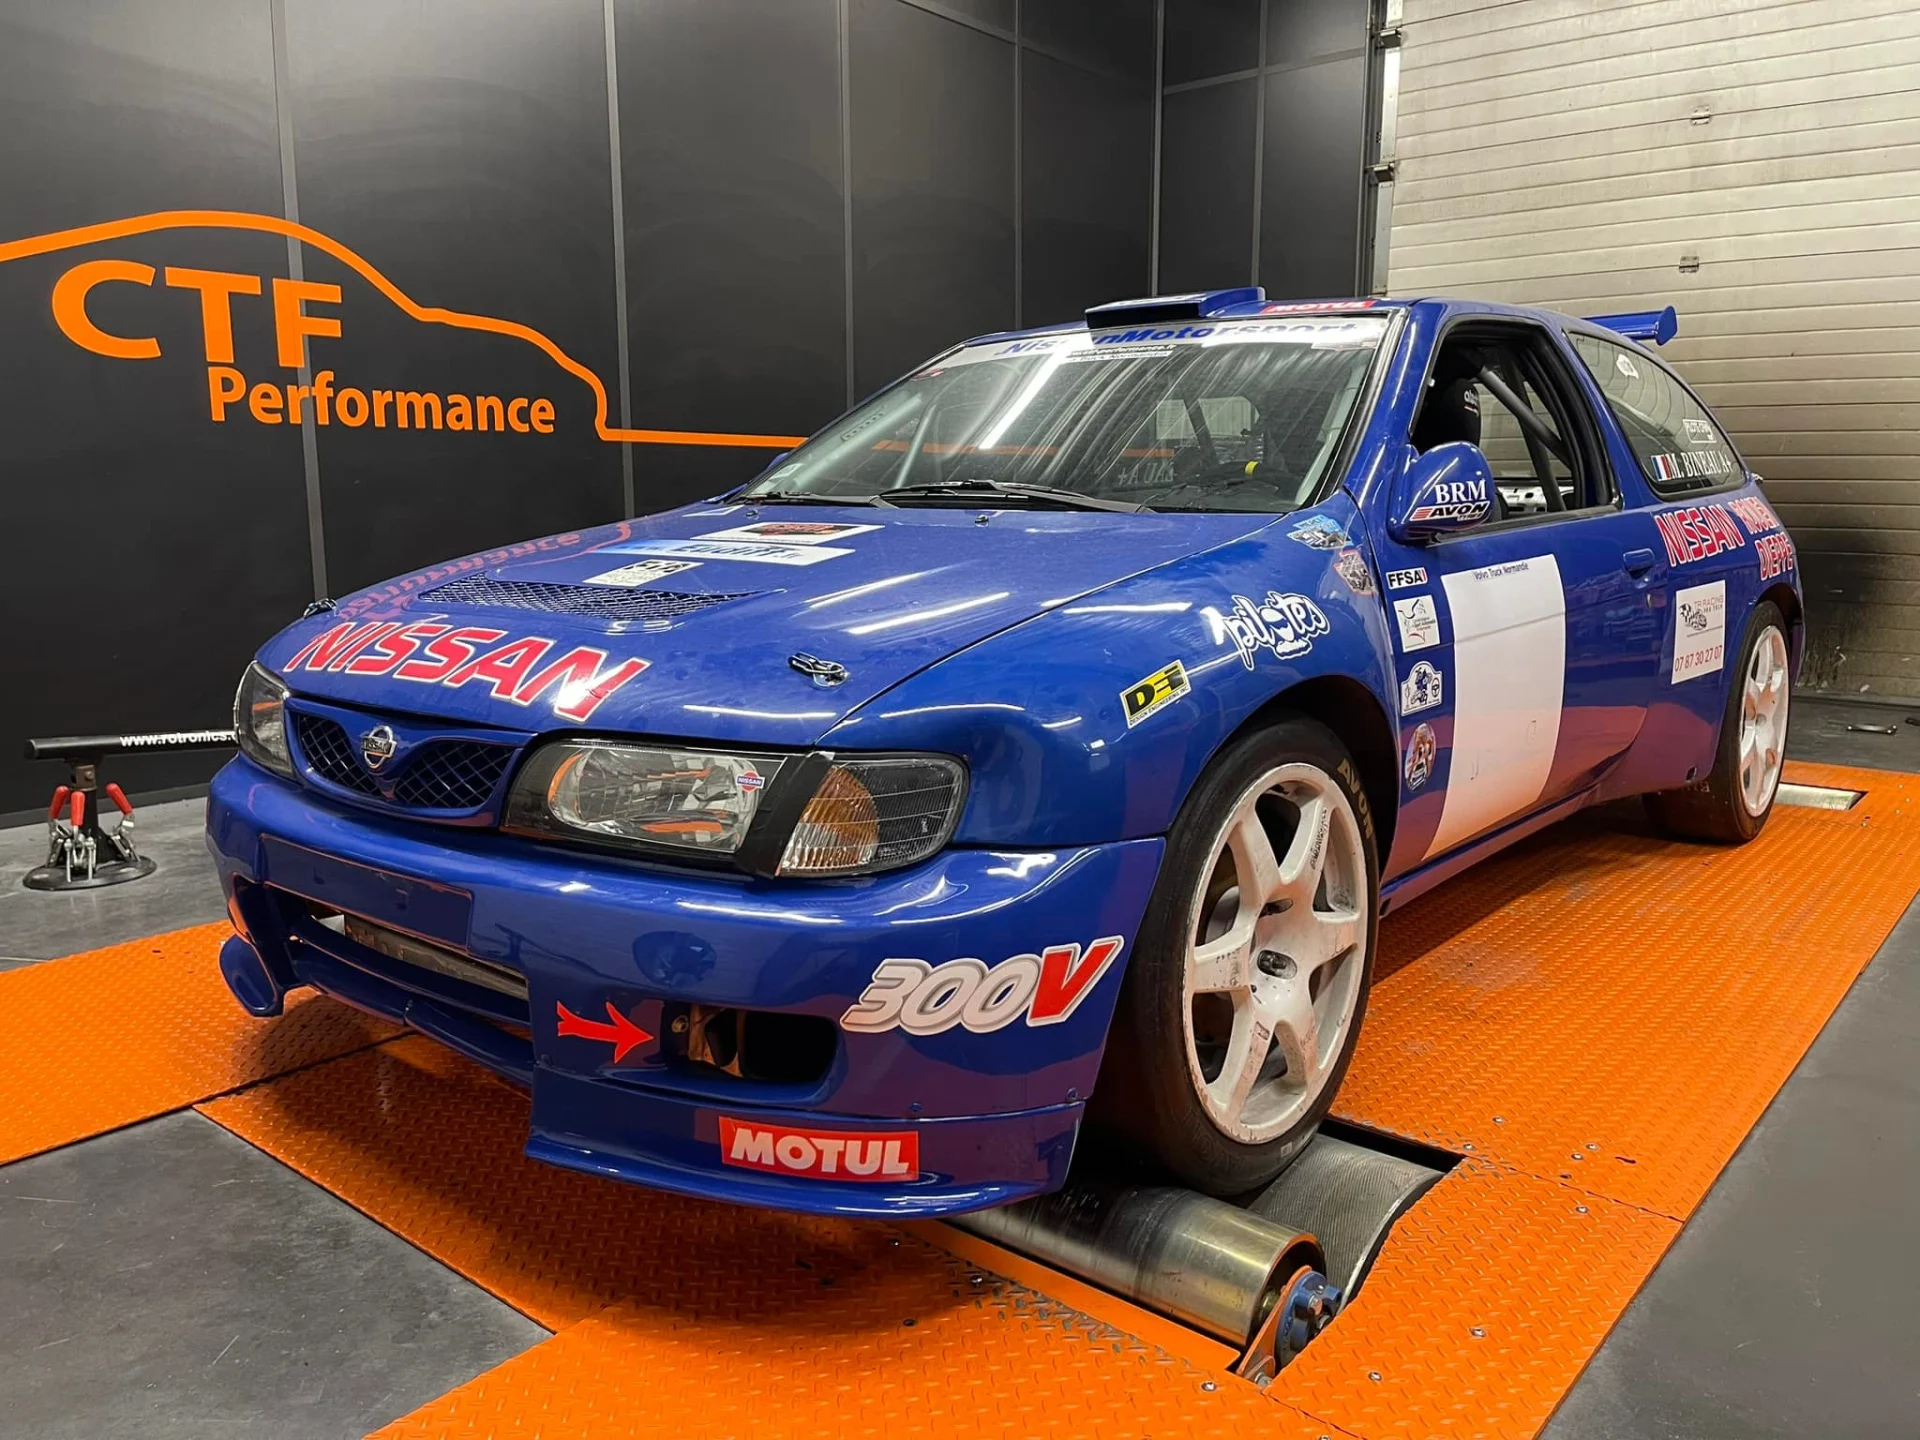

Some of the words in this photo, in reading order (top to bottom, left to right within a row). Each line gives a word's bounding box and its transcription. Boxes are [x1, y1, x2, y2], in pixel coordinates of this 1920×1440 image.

[52, 260, 342, 368] CTF
[1269, 301, 1366, 312] MOTUL
[208, 366, 556, 434] Performance
[1680, 450, 1722, 478] BINEAU
[1434, 478, 1487, 505] BRM
[1430, 502, 1489, 517] AVON
[1653, 503, 1746, 568] NISSAN
[1387, 568, 1424, 588] FFSA
[283, 621, 652, 724] NISSAN
[1674, 655, 1684, 673] 07
[1684, 652, 1694, 669] 87
[1694, 649, 1704, 666] 30
[1704, 647, 1714, 663] 27
[1714, 644, 1723, 660] 07
[738, 777, 762, 786] NISSAN
[839, 936, 1124, 1036] 300V
[730, 1126, 910, 1176] MOTUL
